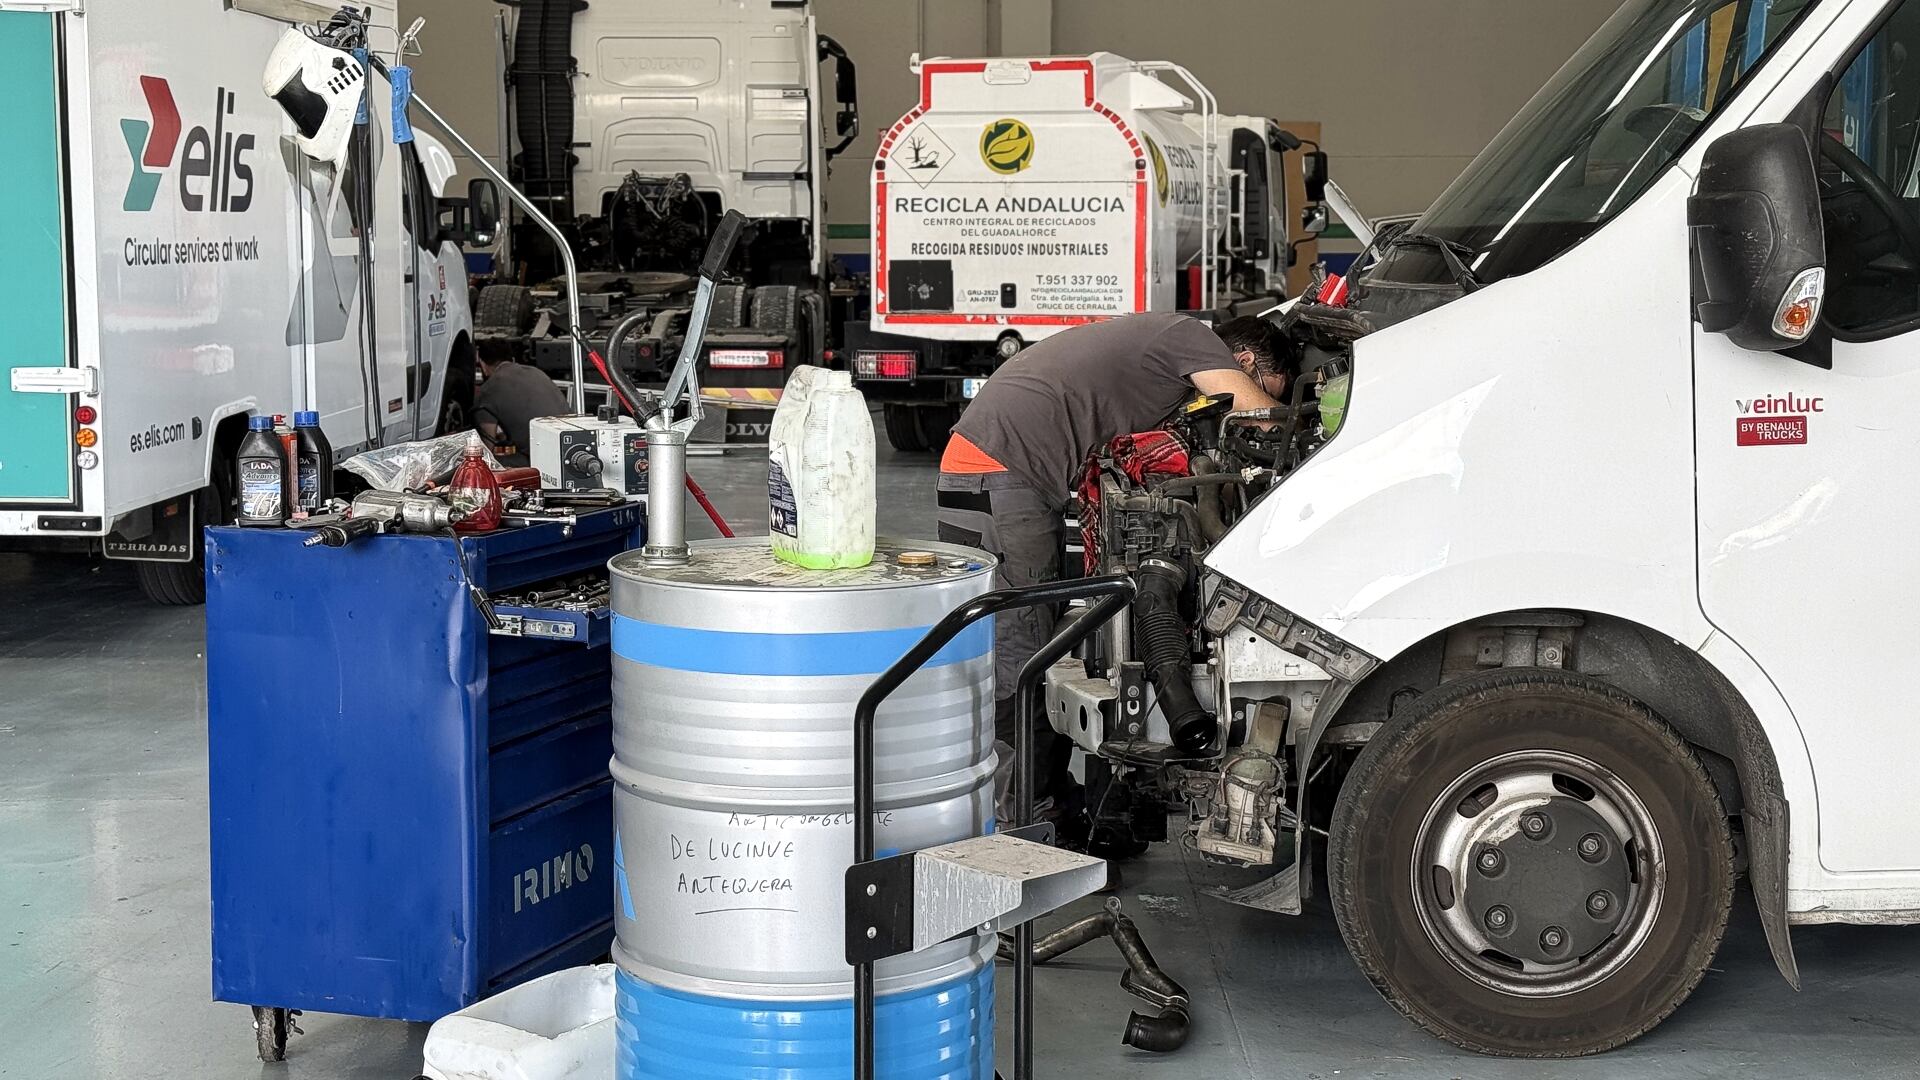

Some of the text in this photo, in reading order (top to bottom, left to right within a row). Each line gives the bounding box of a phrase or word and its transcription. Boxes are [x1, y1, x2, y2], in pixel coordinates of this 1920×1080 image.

[179, 86, 255, 213] elis
[895, 197, 1125, 213] RECICLA ANDALUCIA
[923, 217, 1096, 226] CENTRO INTEGRAL DE RECICLADOS
[961, 228, 1057, 237] DEL GUADALHORCE
[124, 235, 259, 266] Circular services at work
[911, 243, 1108, 256] RECOGIDA RESIDUOS INDUSTRIALES
[1036, 275, 1118, 286] T.951 337 902
[1076, 303, 1118, 311] CERRALBA
[1735, 392, 1824, 414] veinluc
[1741, 421, 1803, 432] BY RENAULT
[130, 422, 185, 453] es.elis.com
[1757, 430, 1803, 440] TRUCKS
[108, 542, 187, 553] TERRADAS
[670, 834, 696, 860] DE
[514, 843, 594, 913] IRIMO
